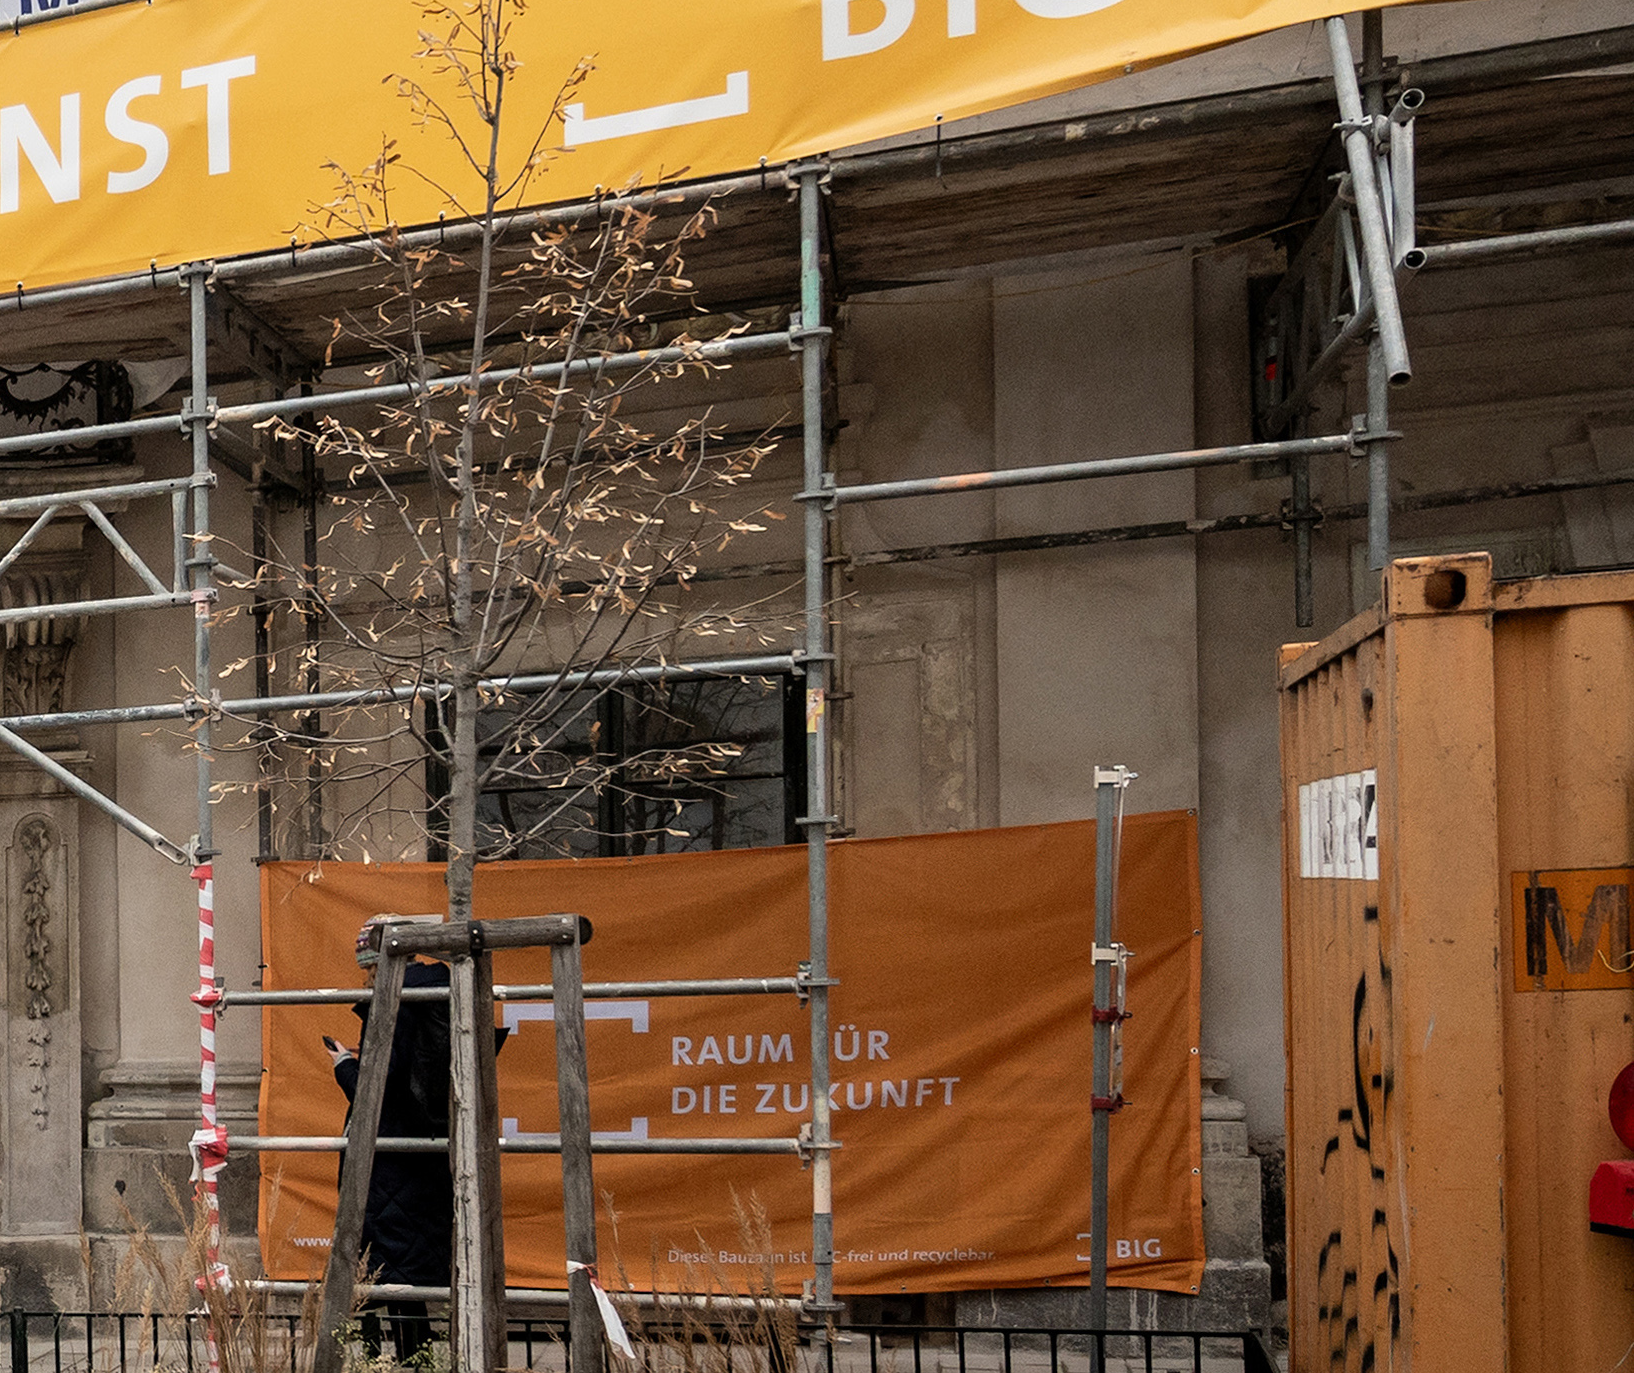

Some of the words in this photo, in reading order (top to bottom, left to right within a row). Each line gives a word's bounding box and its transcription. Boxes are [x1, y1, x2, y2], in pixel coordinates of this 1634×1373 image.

[672, 1034, 794, 1065] RAUM
[828, 1024, 890, 1061] ÜR
[672, 1085, 737, 1114] DIE
[668, 1250, 715, 1263] Diese
[789, 1251, 807, 1263] ist
[879, 1249, 908, 1262] und
[1116, 1235, 1161, 1258] BIG
